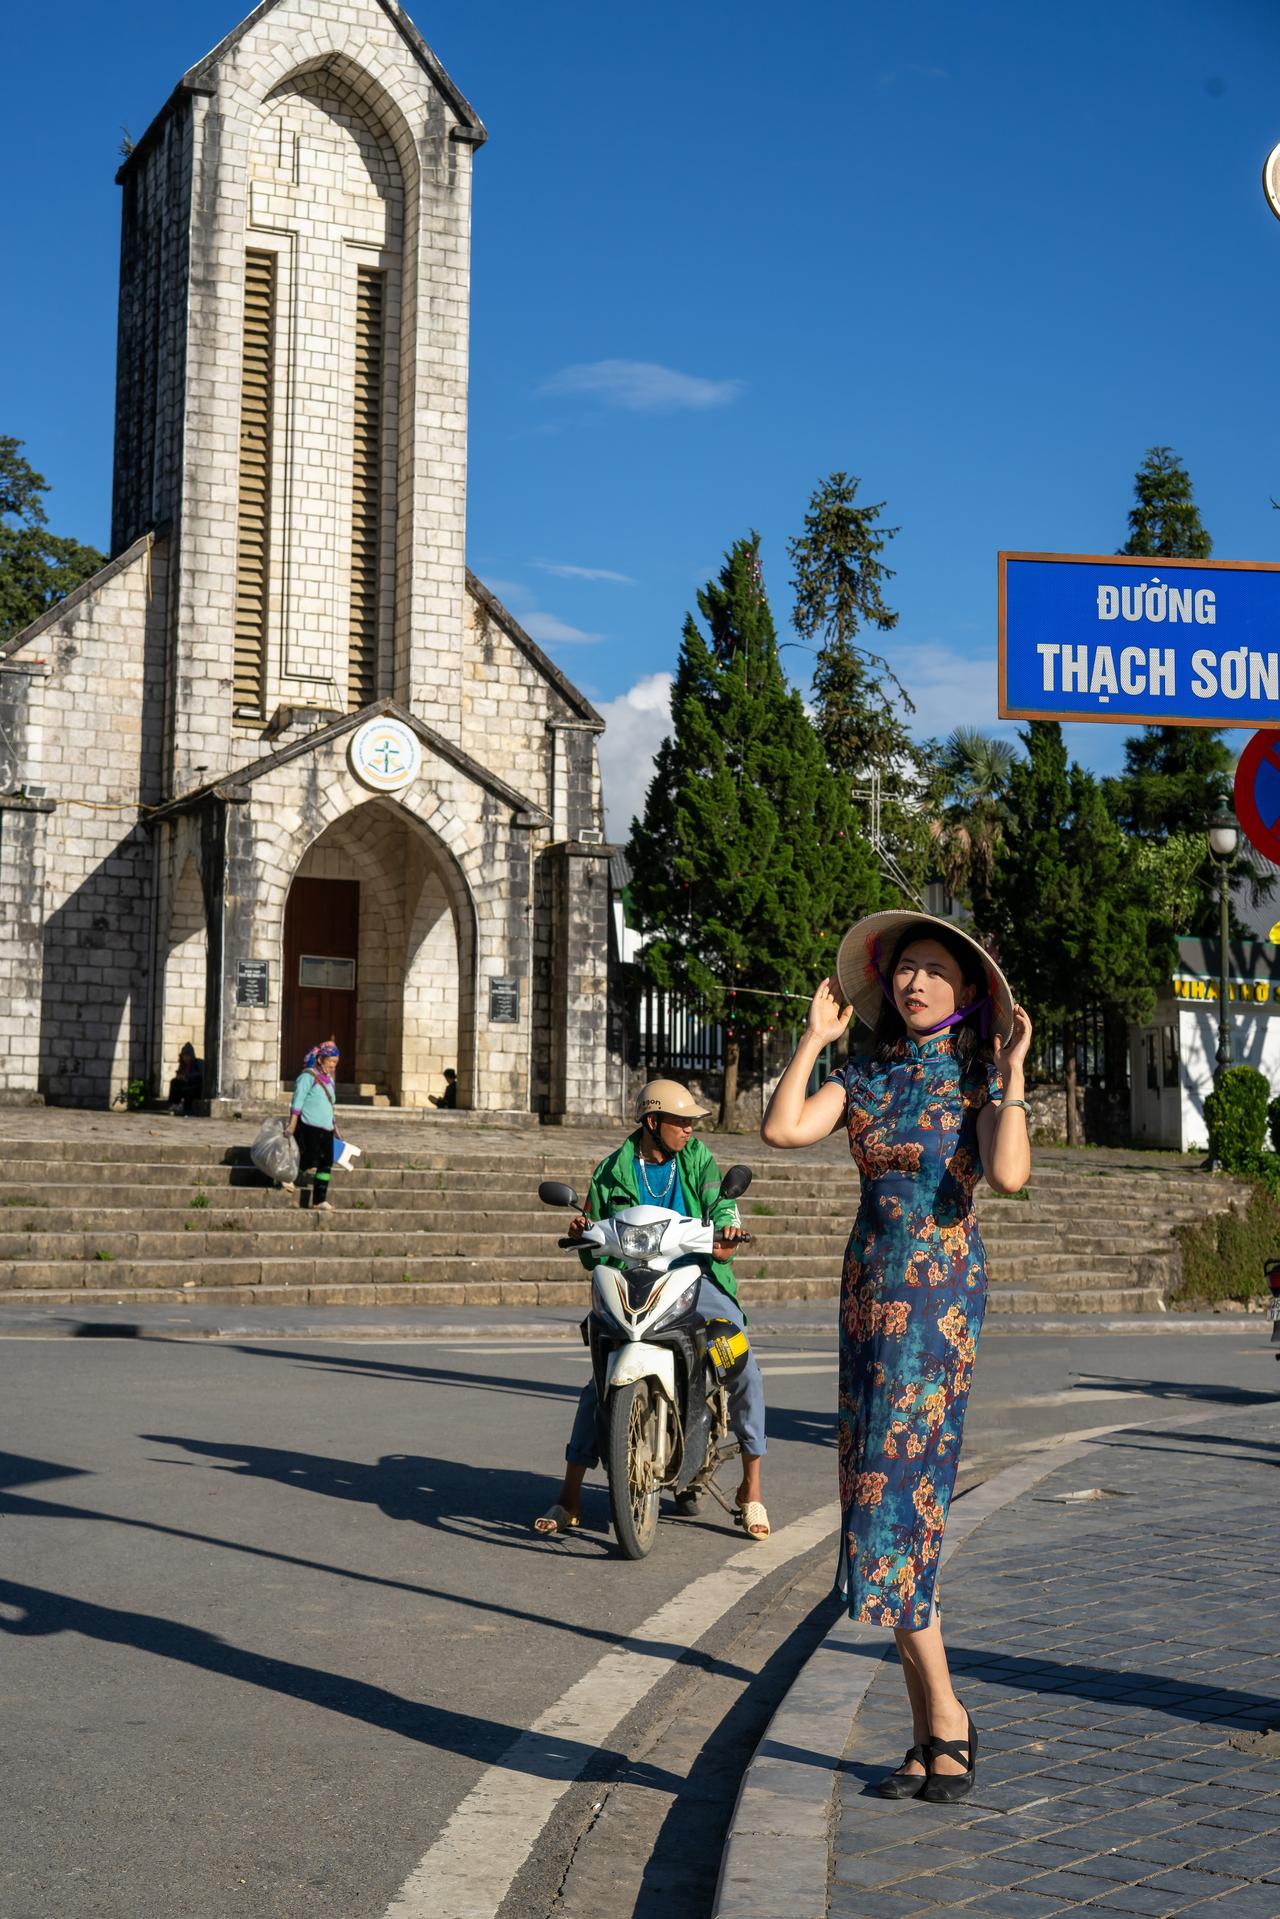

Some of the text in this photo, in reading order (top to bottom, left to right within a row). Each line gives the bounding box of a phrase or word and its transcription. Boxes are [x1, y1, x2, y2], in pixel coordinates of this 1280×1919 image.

[1097, 577, 1216, 625] ĐƯỜNG
[1036, 643, 1279, 703] THẠCH SƠN
